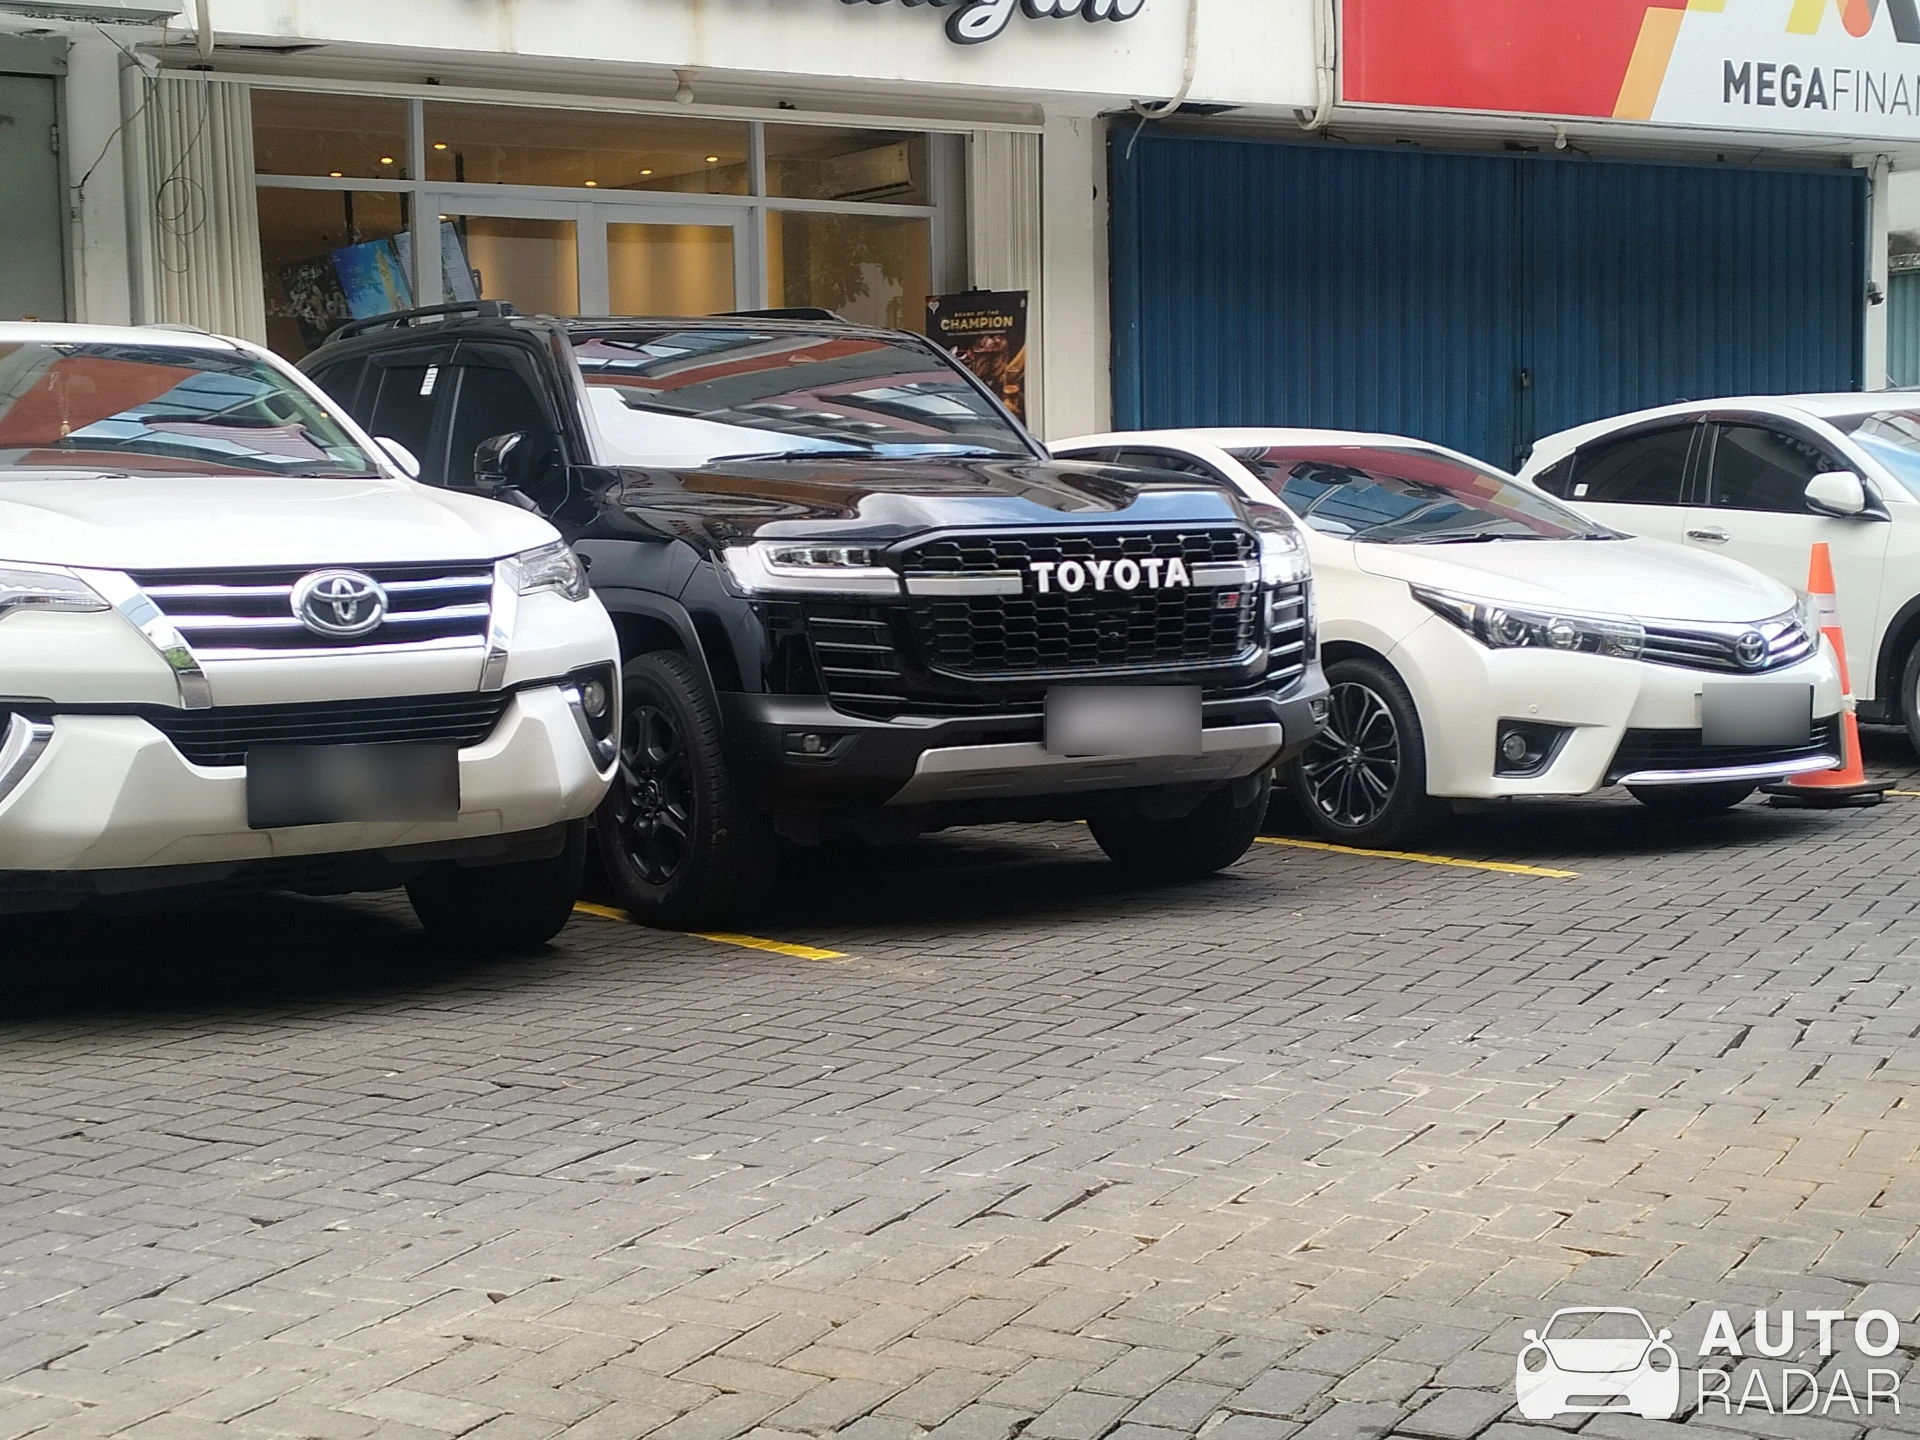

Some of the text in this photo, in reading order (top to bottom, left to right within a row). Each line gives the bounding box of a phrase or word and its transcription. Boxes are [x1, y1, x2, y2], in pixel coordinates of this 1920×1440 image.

[1723, 59, 1920, 117] MEGAFINA
[940, 316, 1013, 330] CHAMPION
[1030, 557, 1190, 593] TOYOTA
